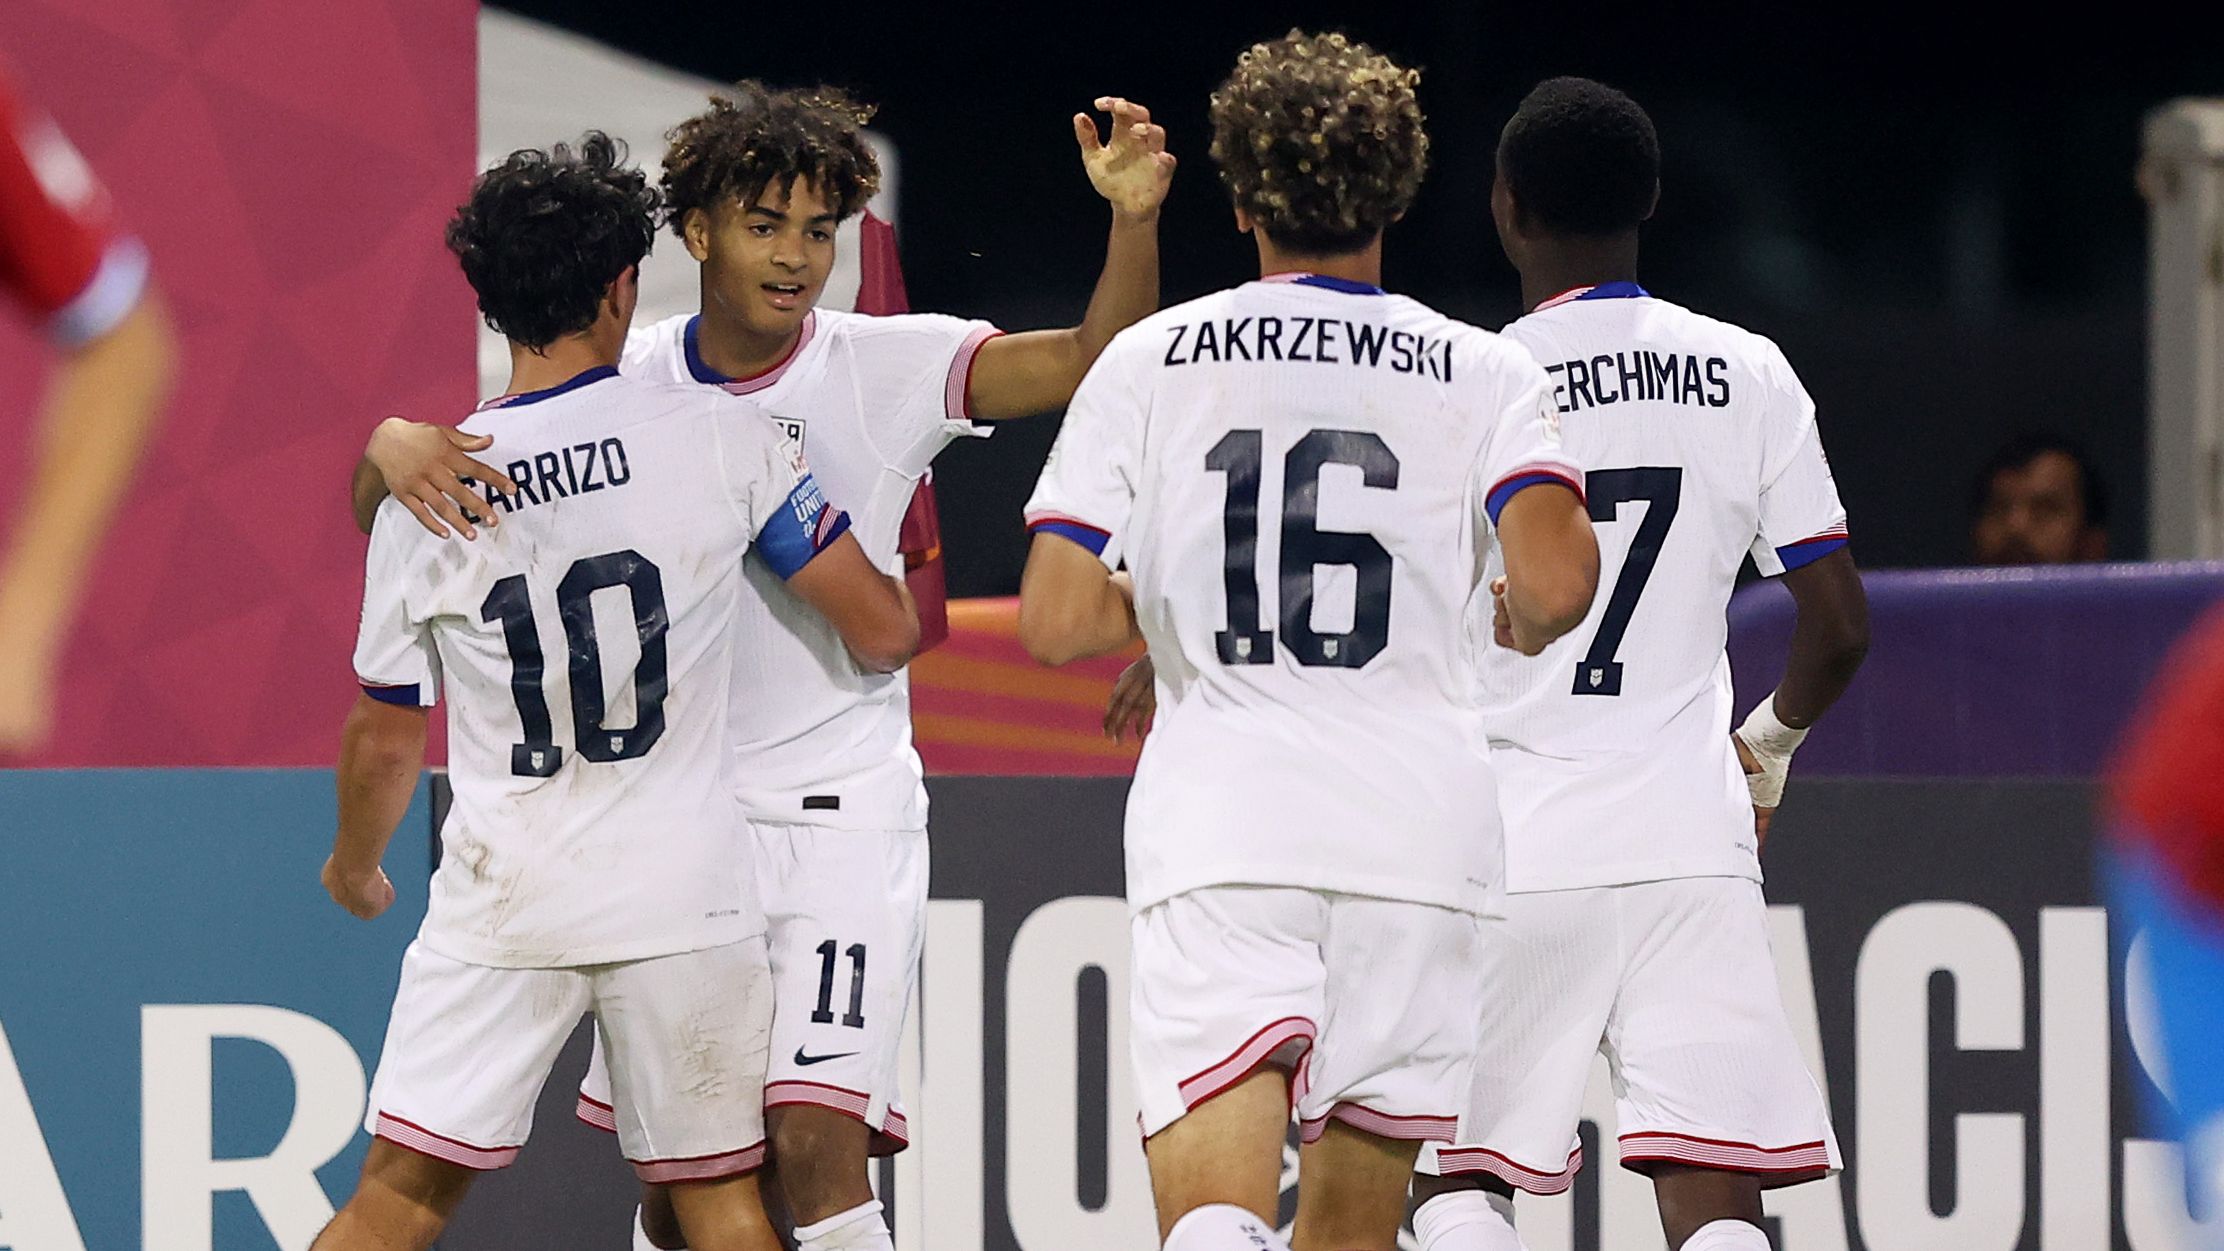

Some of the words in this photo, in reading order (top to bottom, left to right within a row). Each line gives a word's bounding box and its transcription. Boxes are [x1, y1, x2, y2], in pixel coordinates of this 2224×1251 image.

[1164, 317, 1452, 383] ZAKRZEWSKI
[1544, 351, 1730, 412] ERCHIMAS
[1205, 428, 1400, 669] 16
[1571, 466, 1683, 696] 7
[481, 549, 670, 777] 10
[811, 939, 867, 1029] 11
